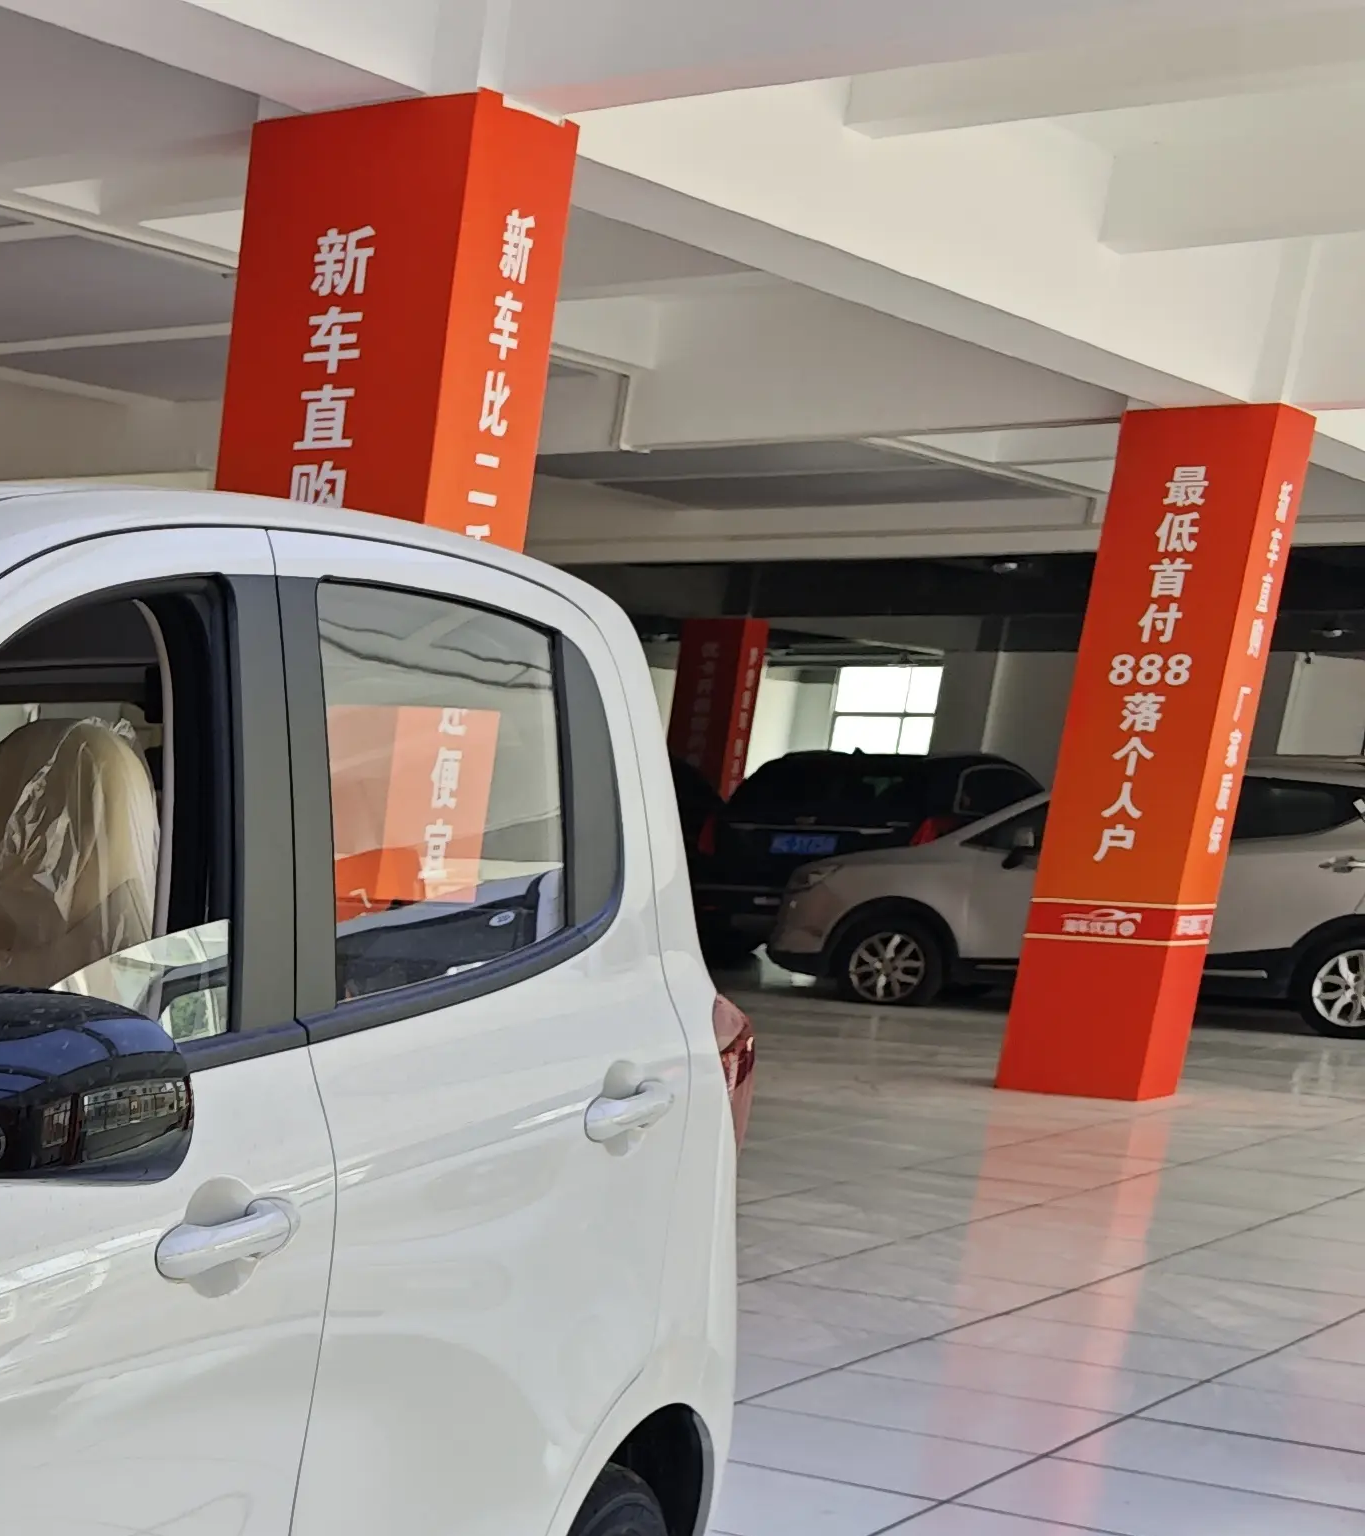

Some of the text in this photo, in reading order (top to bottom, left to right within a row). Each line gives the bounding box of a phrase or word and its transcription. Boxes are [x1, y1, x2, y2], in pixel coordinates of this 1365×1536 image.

[289, 225, 377, 509] 新车直购
[1094, 465, 1209, 862] 最低首付888落个人户
